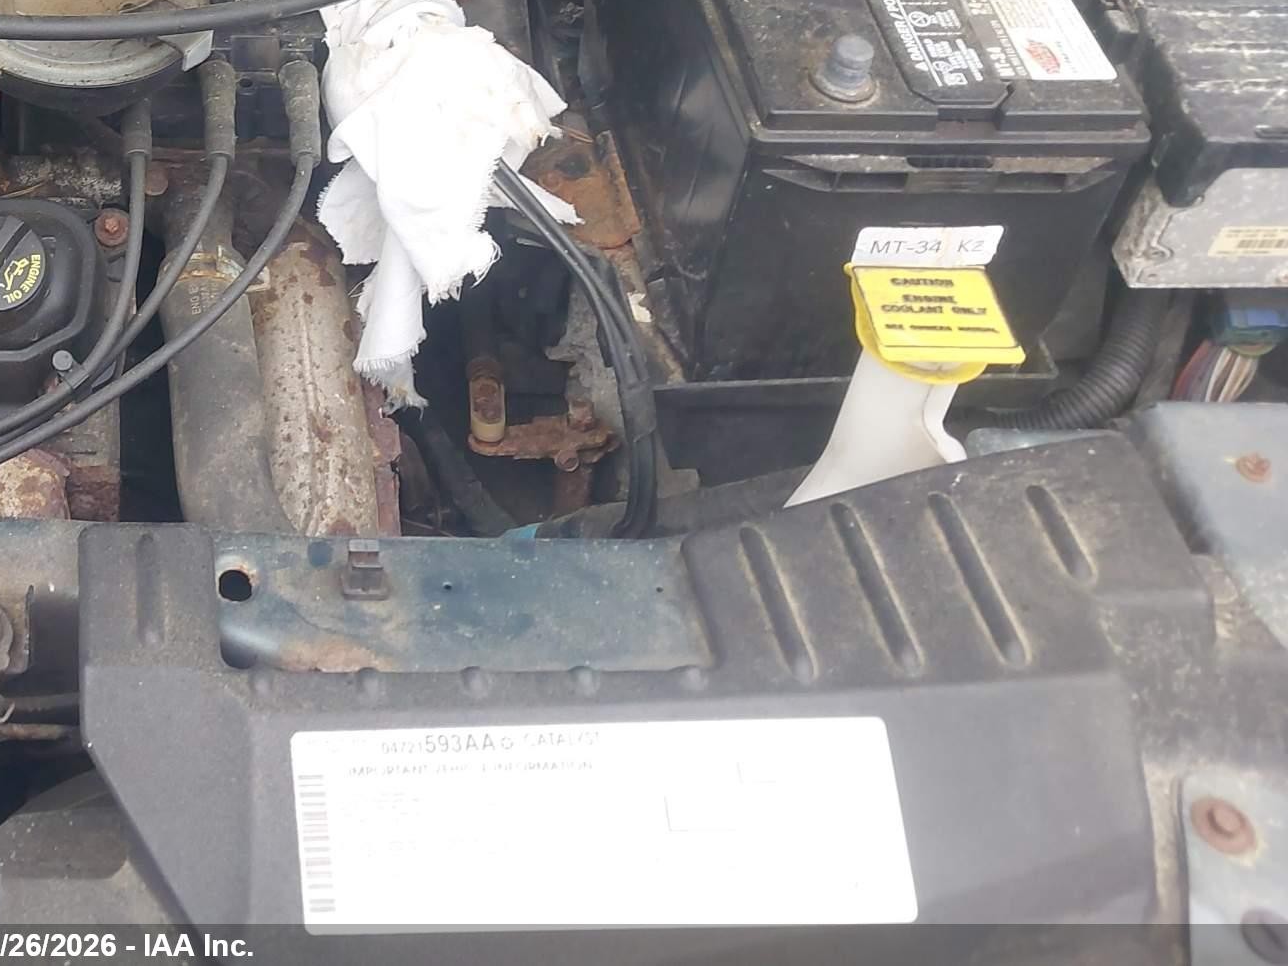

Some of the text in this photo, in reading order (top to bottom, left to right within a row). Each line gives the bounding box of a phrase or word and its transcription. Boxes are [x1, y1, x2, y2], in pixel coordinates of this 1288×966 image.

[869, 239, 986, 254] MT-34 K2
[2, 254, 41, 304] ENGINE OIL
